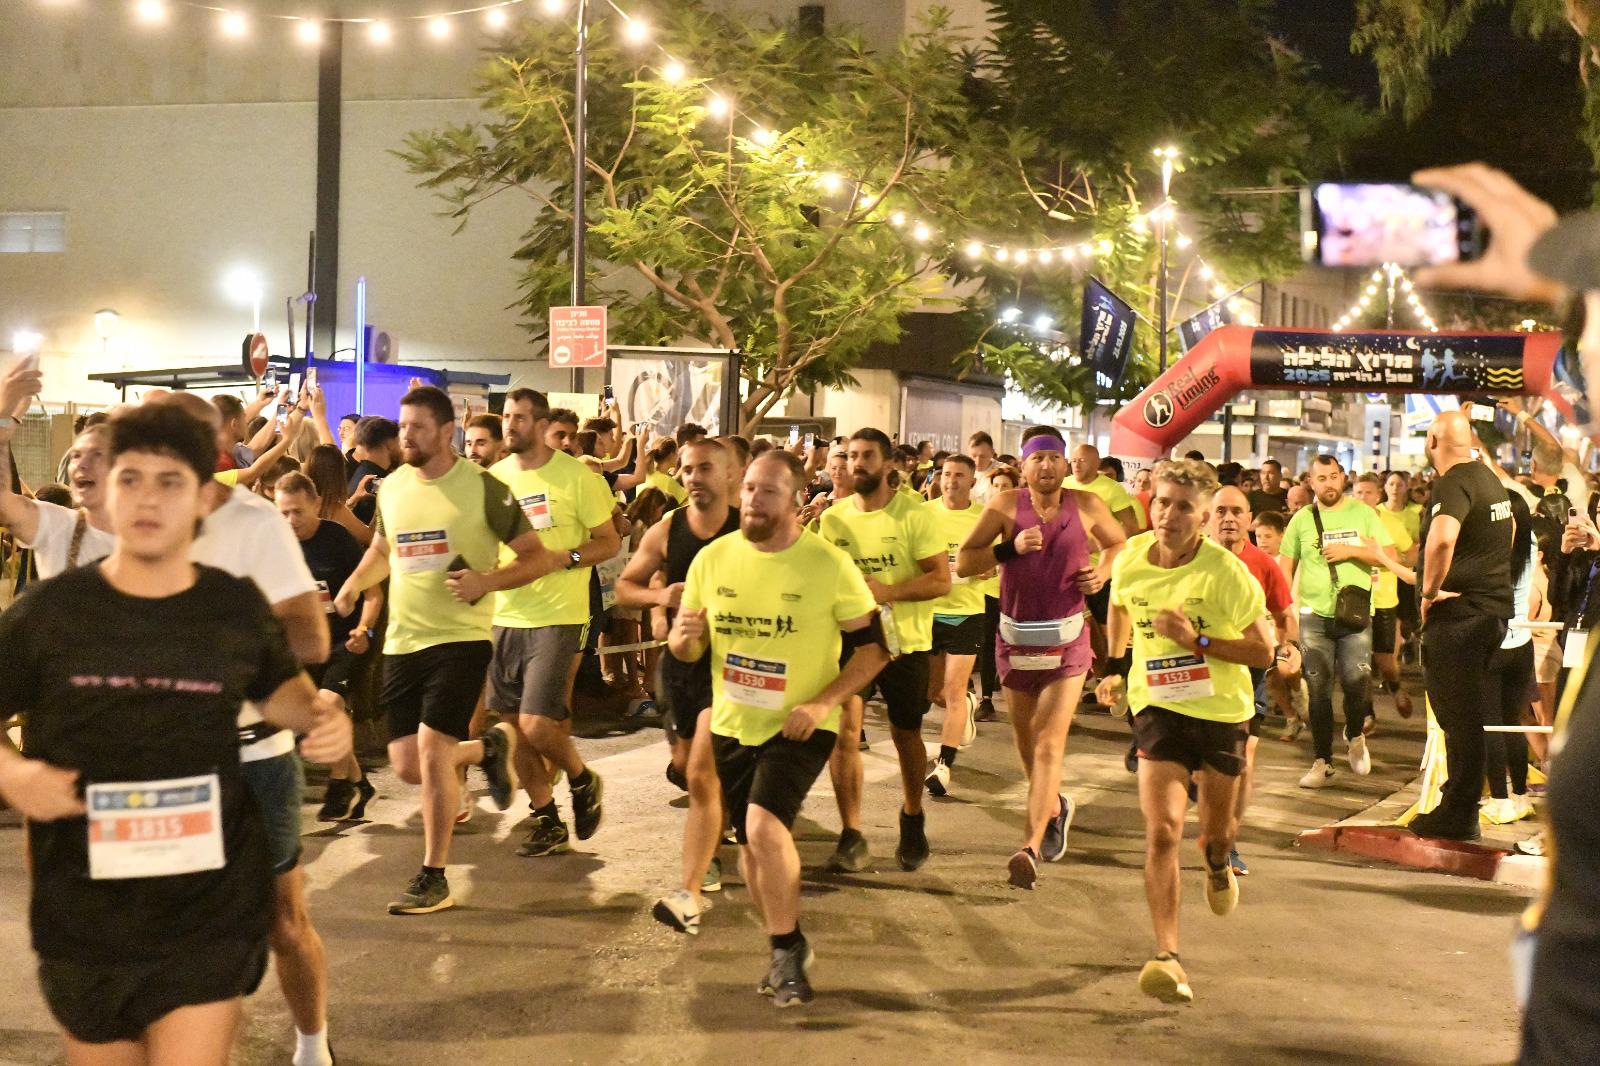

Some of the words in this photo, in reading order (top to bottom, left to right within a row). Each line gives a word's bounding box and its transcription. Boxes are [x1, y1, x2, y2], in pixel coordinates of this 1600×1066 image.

[1283, 345, 1352, 368] הלילה
[1356, 350, 1413, 371] מרוץ
[1167, 366, 1201, 399] Real
[1283, 368, 1331, 381] 2025
[1333, 370, 1382, 382] נהריה
[1384, 367, 1413, 384] של
[1175, 364, 1220, 408] Timing
[745, 616, 772, 627] מרוץ
[738, 672, 766, 688] 1530
[1163, 671, 1191, 685] 1523
[127, 818, 184, 841] 1815
